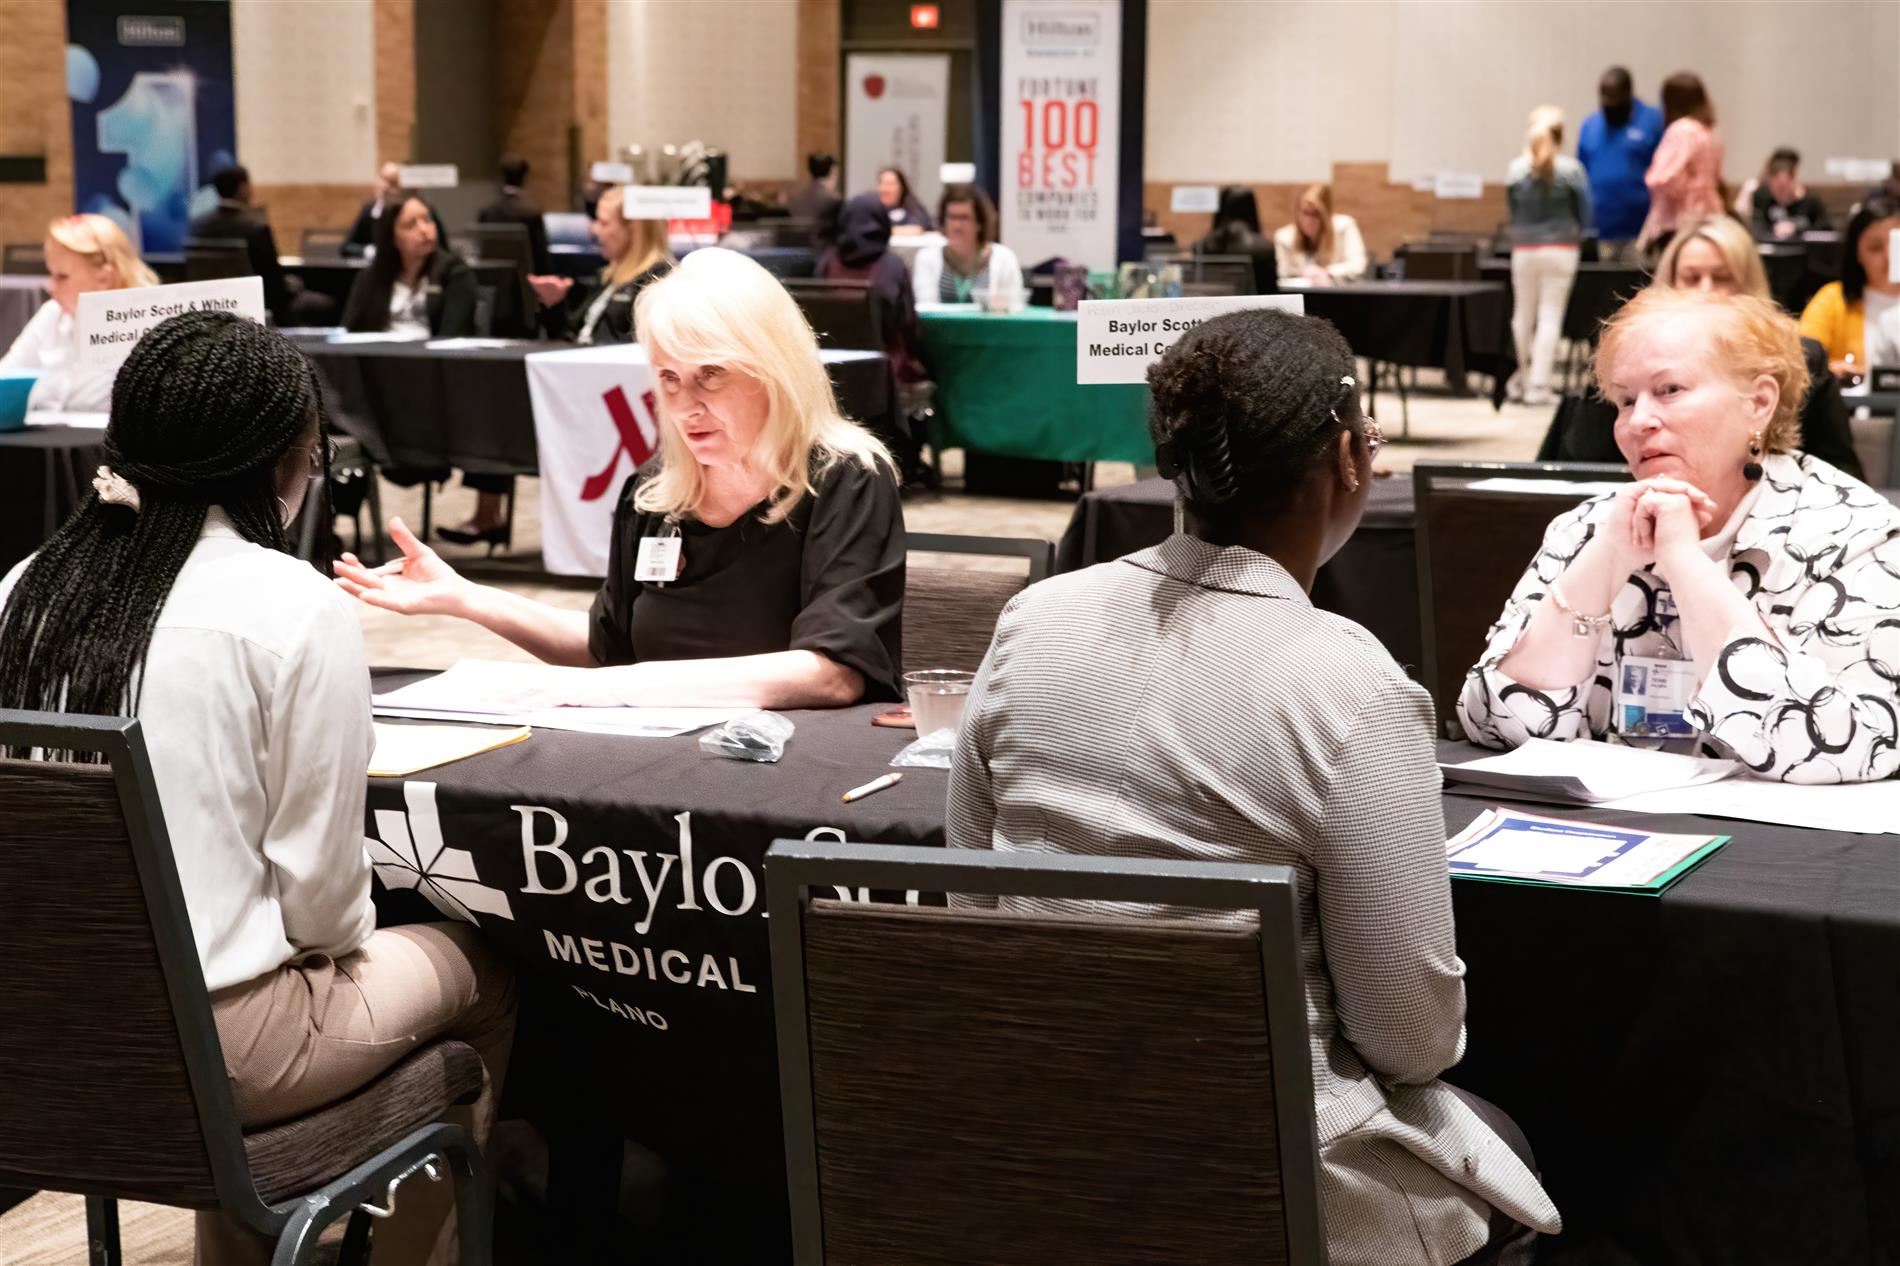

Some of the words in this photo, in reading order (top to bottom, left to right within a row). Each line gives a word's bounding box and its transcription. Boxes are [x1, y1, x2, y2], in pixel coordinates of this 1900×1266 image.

[1020, 99, 1099, 150] 100
[1018, 151, 1099, 188] BEST
[105, 308, 146, 323] Baylor
[150, 303, 185, 317] Scott
[201, 298, 238, 311] White
[89, 328, 138, 346] Medical
[1109, 320, 1157, 336] Baylor
[1089, 342, 1149, 357] Medical
[510, 804, 770, 935] Baylo
[542, 929, 757, 993] MEDICAL
